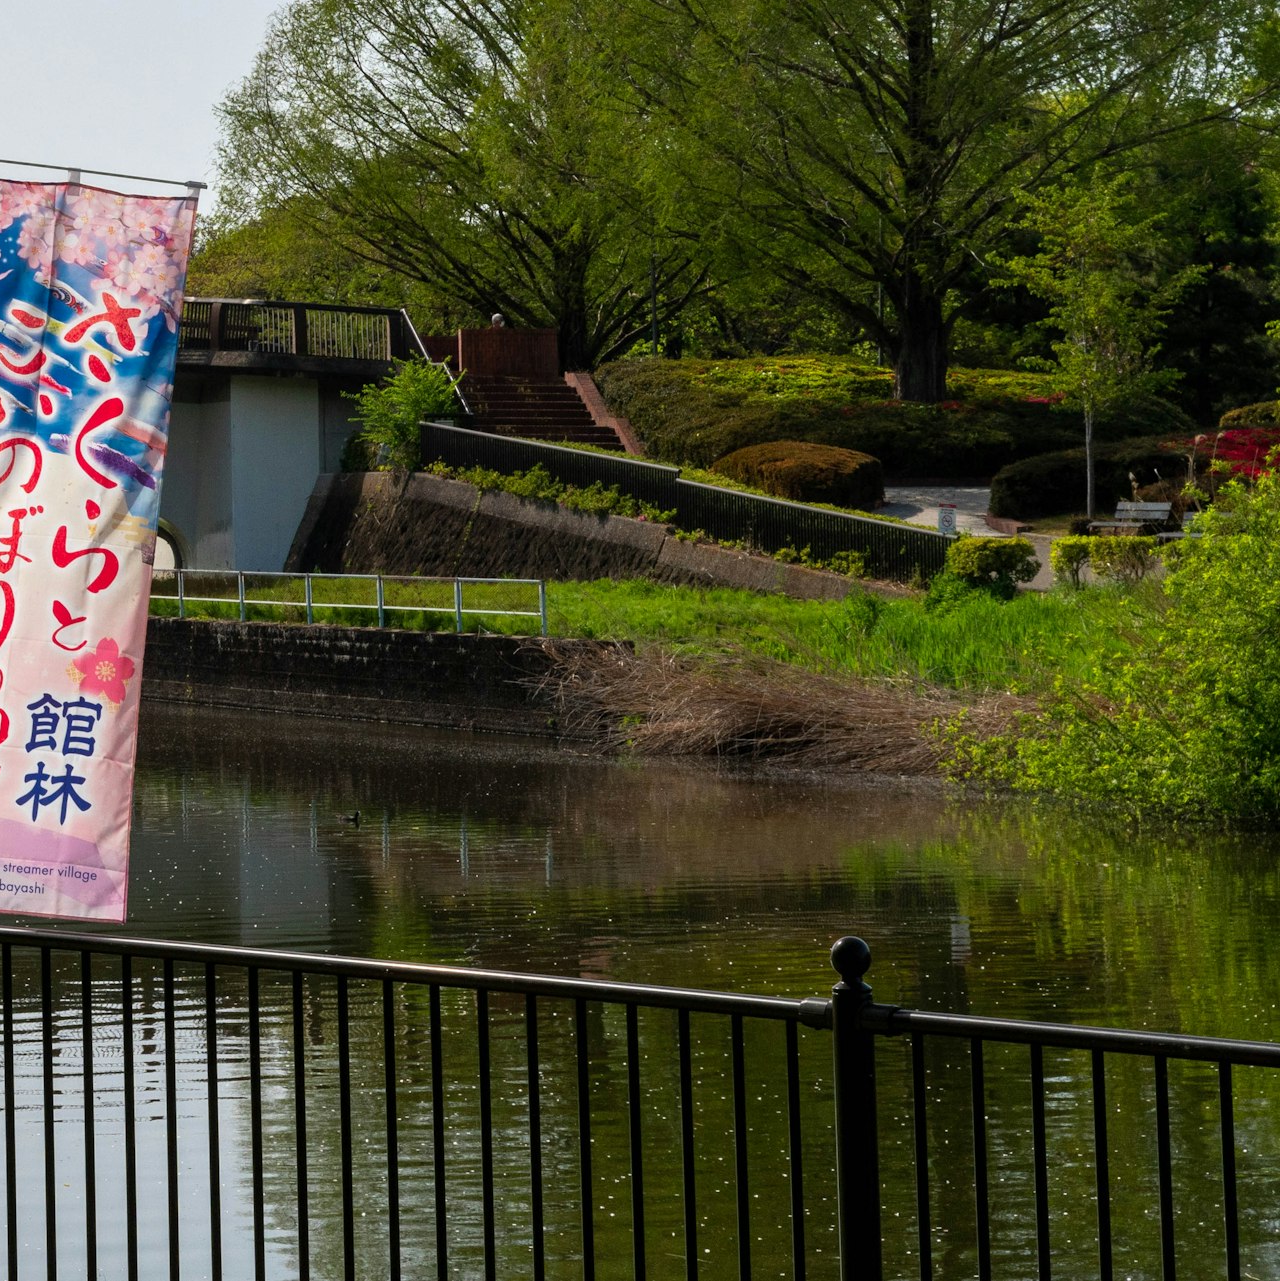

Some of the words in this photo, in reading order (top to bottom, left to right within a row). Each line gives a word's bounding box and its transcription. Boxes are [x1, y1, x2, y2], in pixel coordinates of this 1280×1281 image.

[52, 291, 142, 652] さくらと
[15, 692, 103, 826] 館林
[2, 861, 54, 876] streamer
[57, 865, 98, 883] village
